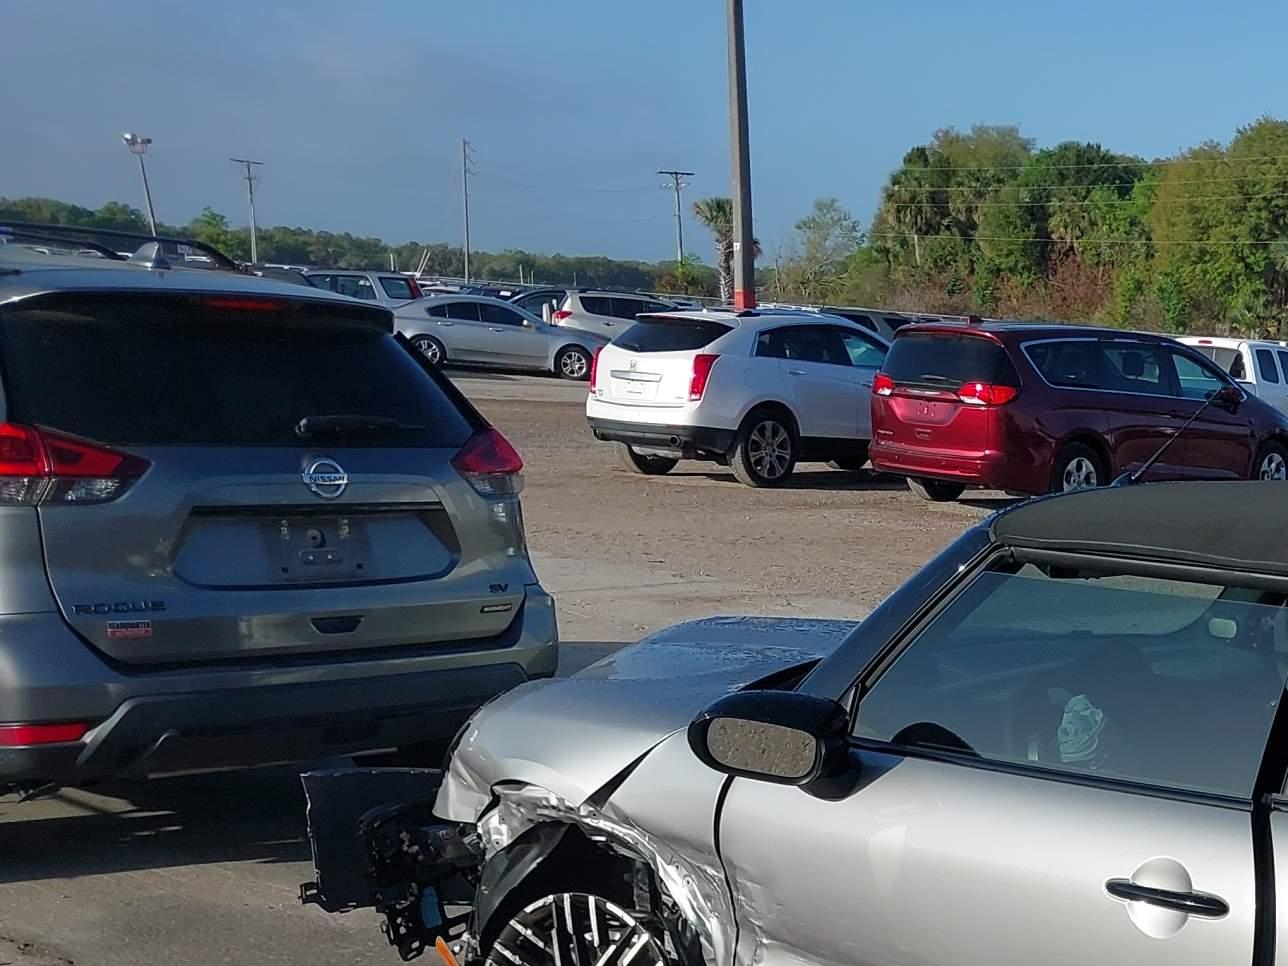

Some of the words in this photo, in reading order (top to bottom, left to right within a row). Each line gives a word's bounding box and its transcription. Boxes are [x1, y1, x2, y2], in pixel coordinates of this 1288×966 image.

[310, 474, 345, 482] NISSAN
[489, 583, 508, 593] SV
[72, 601, 166, 615] ROGUE
